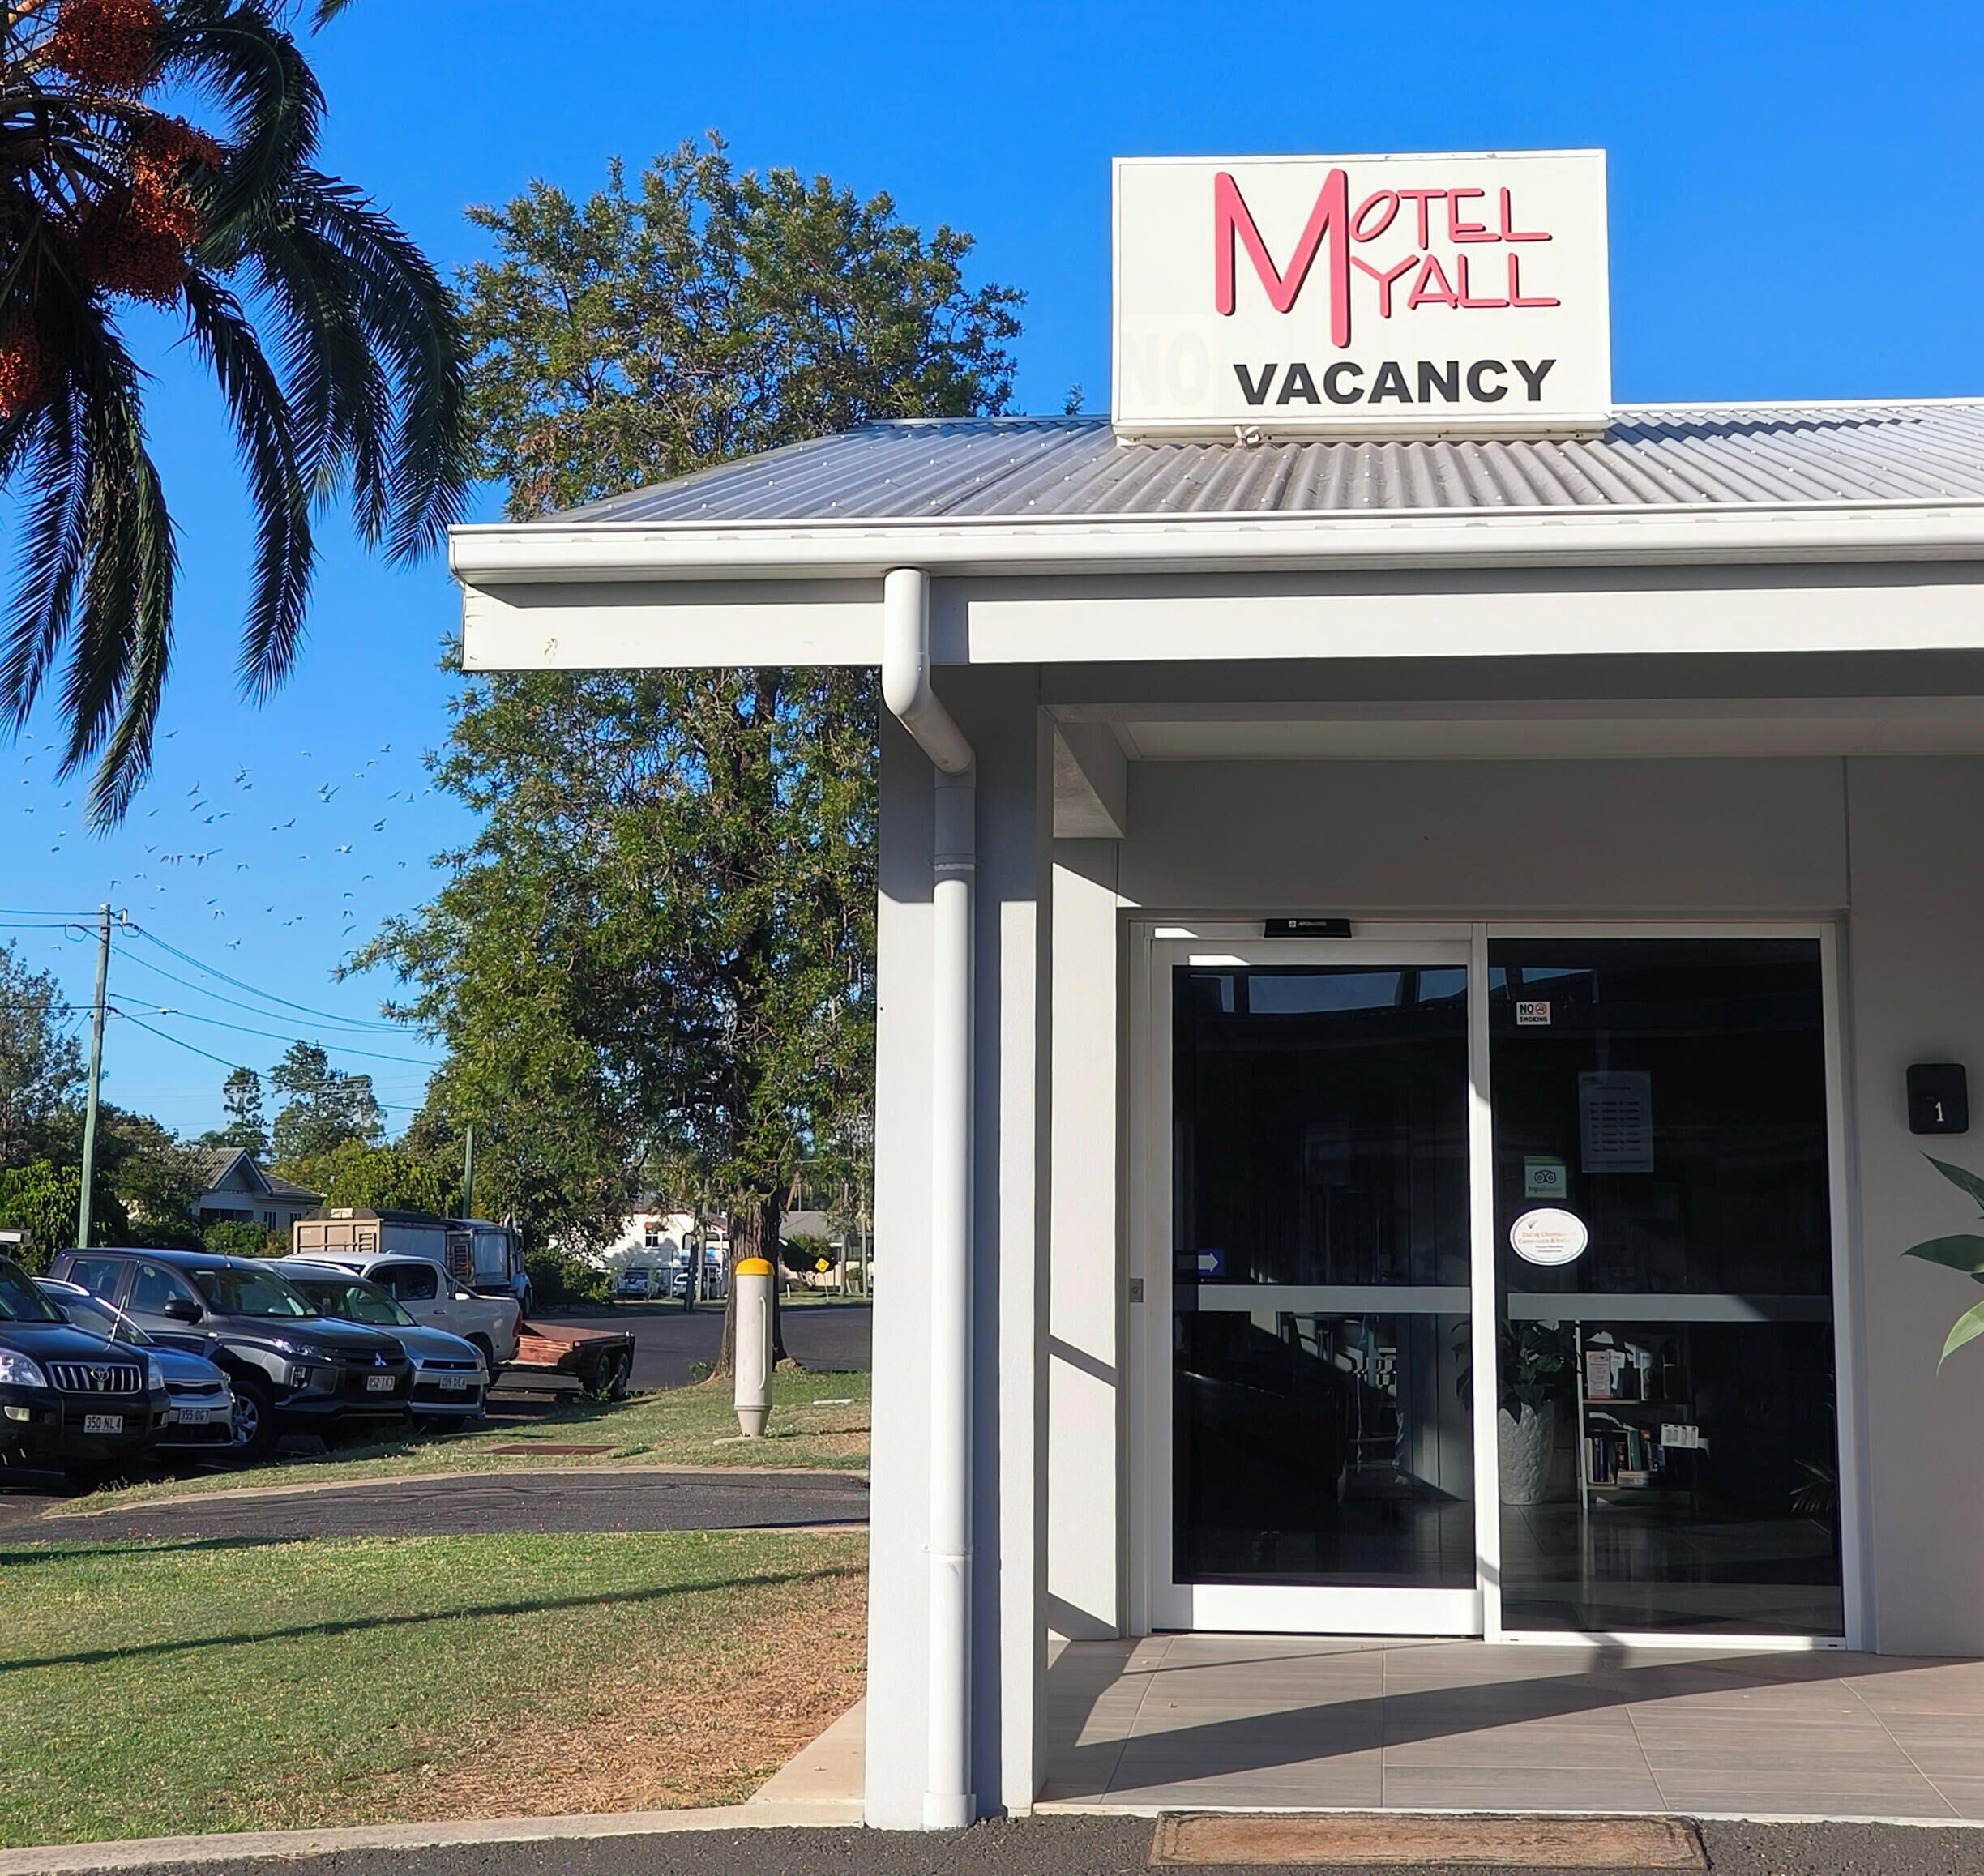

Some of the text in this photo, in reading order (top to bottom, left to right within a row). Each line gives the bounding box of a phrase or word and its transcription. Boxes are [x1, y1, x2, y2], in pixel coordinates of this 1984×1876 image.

[1233, 359, 1557, 405] VACANCY
[1520, 1004, 1534, 1014] NO
[1935, 1101, 1945, 1122] 1
[86, 1416, 101, 1429] 350
